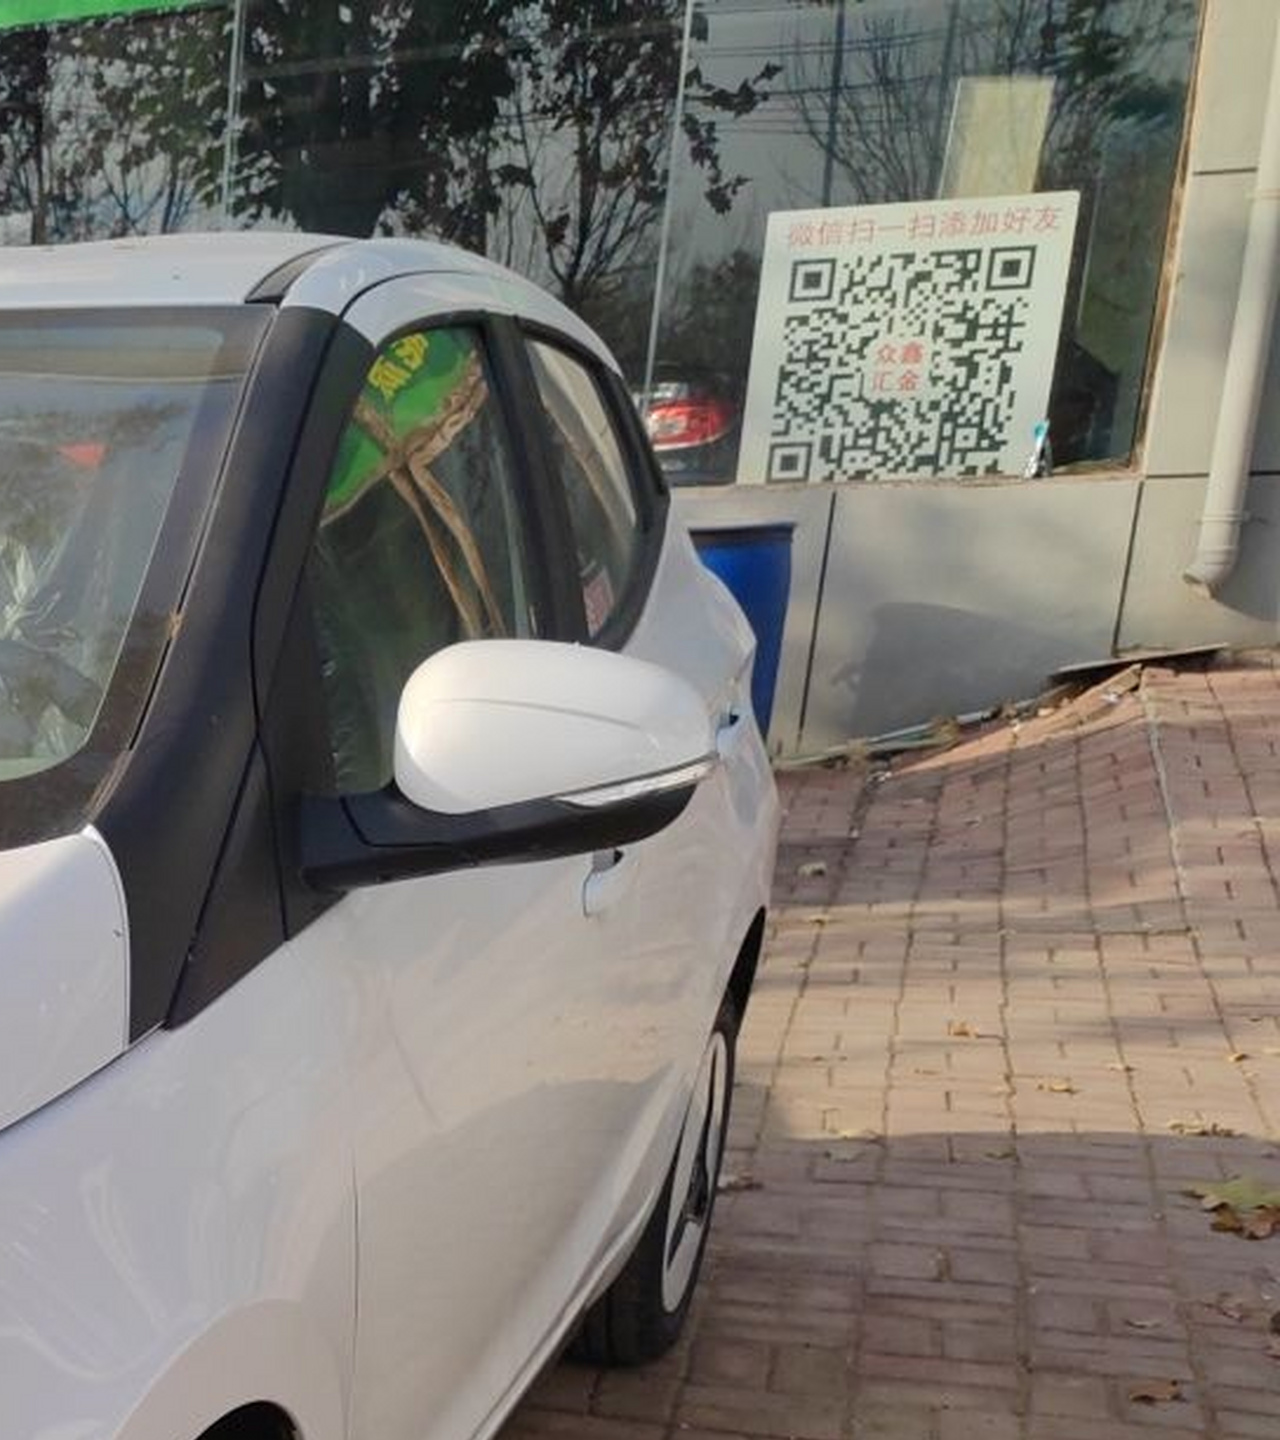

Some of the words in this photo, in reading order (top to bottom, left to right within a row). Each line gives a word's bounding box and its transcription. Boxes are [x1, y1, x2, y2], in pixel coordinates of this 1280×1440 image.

[790, 205, 1061, 246] 微信扫一扫添加好友
